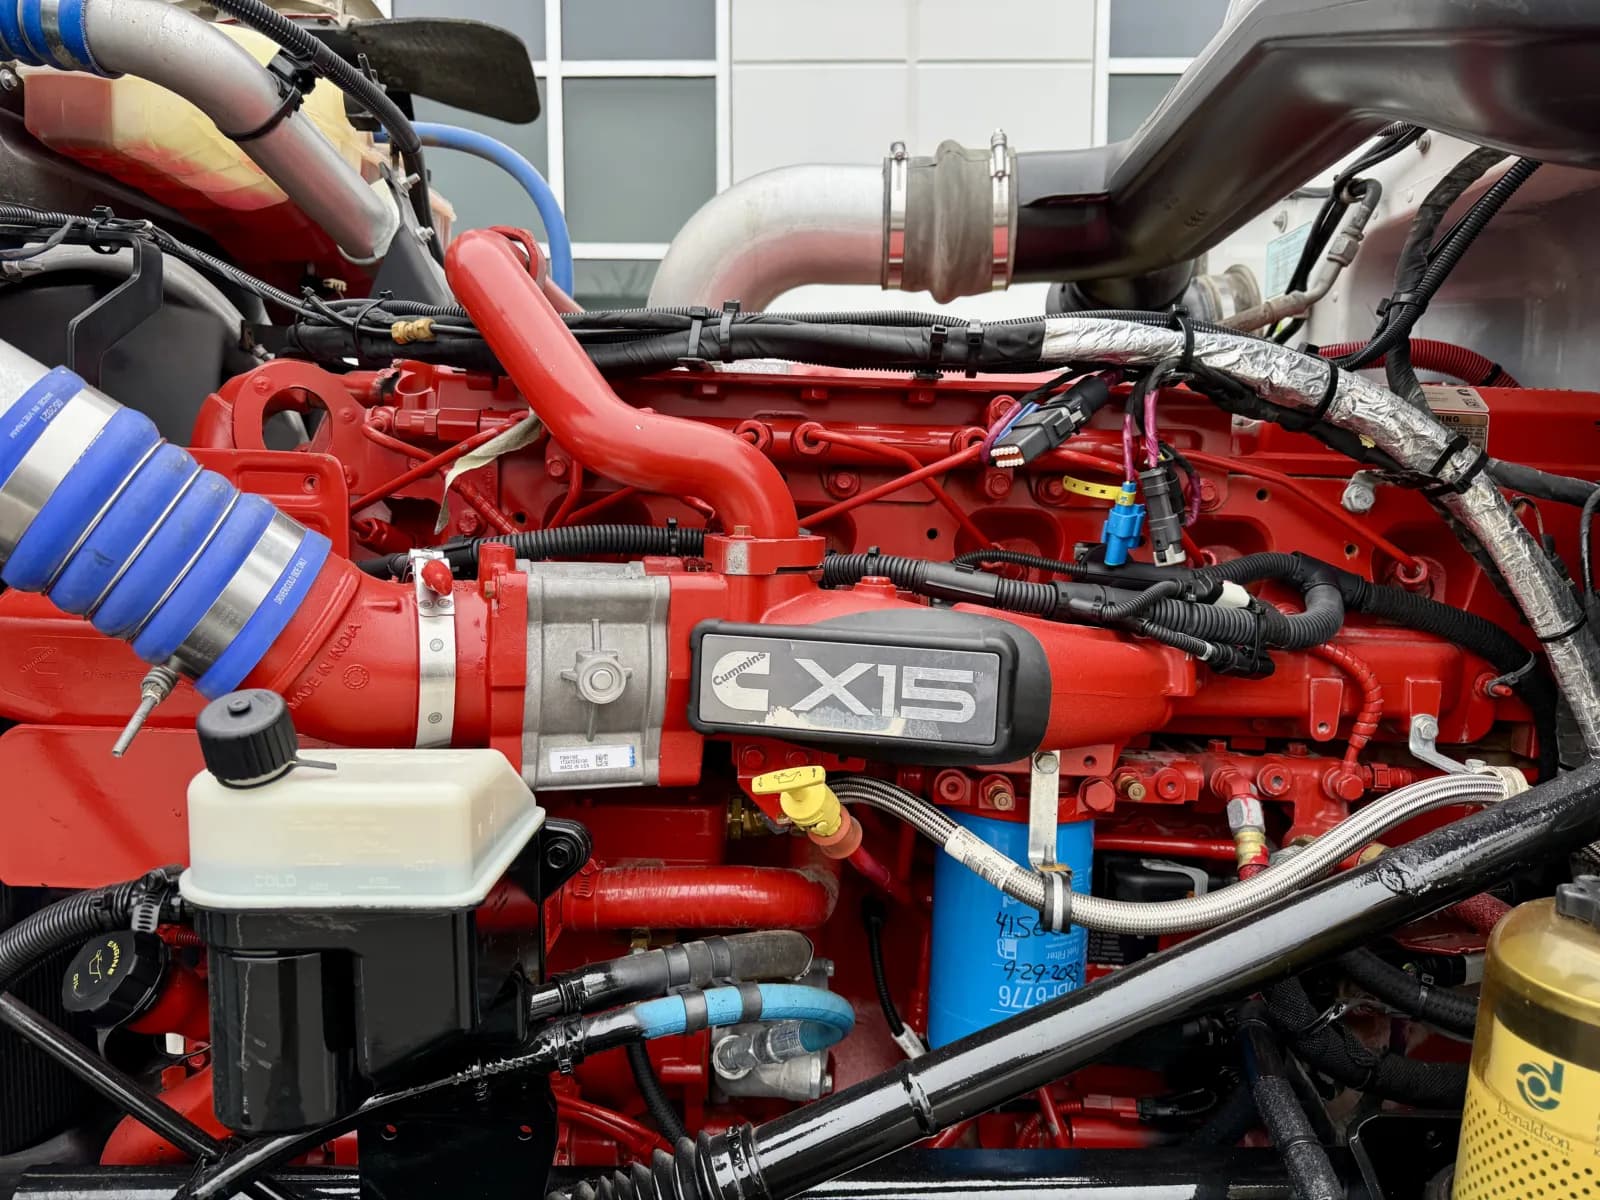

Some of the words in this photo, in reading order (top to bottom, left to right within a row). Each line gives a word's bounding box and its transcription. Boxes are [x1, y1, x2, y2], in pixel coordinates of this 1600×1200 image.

[287, 677, 322, 710] MADE
[317, 662, 334, 676] IN
[329, 622, 362, 659] INDIA
[712, 651, 768, 687] Cummins
[791, 658, 977, 724] X15
[107, 940, 122, 976] ENGINE
[1497, 1100, 1571, 1151] Donaldson
